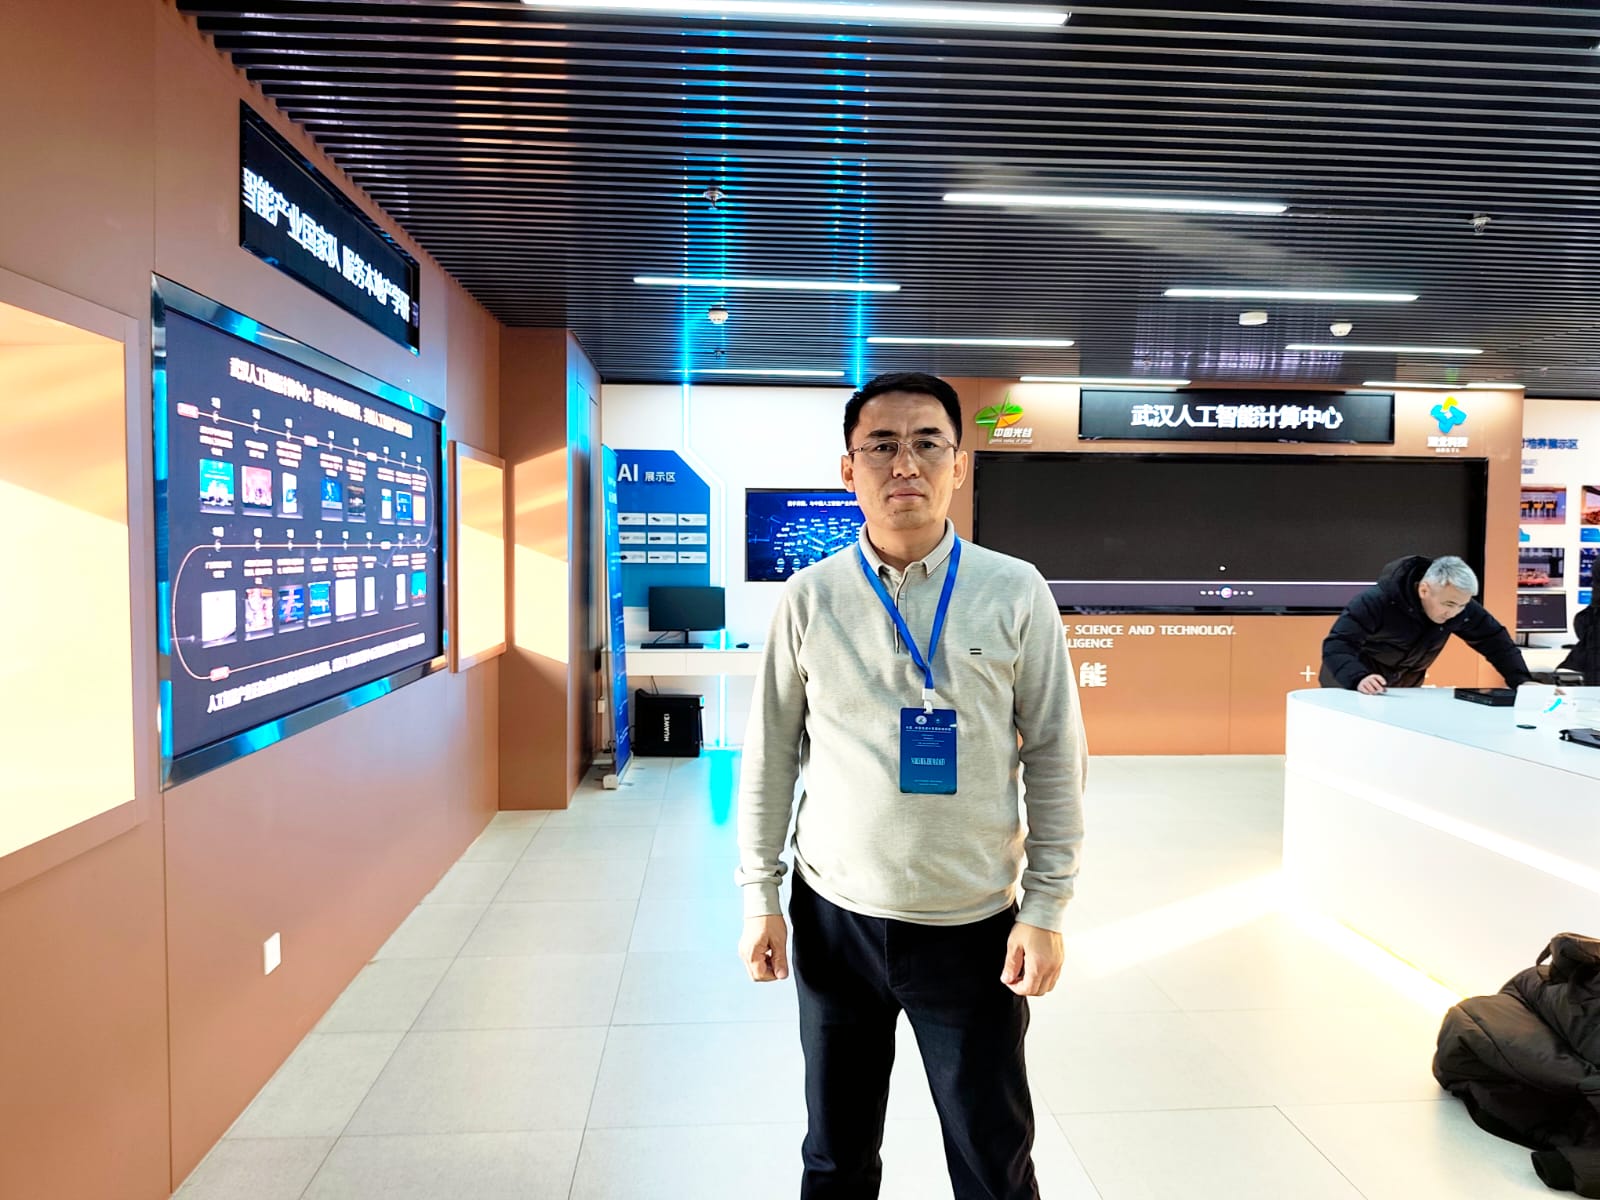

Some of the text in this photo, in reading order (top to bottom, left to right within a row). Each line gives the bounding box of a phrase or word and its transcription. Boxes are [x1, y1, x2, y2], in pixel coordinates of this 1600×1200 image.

[1131, 403, 1344, 429] 武汉人工智能计算中心
[617, 463, 639, 482] AI
[644, 471, 676, 483] 展示区
[1075, 624, 1124, 635] SCIENCE
[1128, 624, 1155, 635] AND
[1067, 638, 1114, 648] LIGENCE
[1079, 661, 1107, 688] 能
